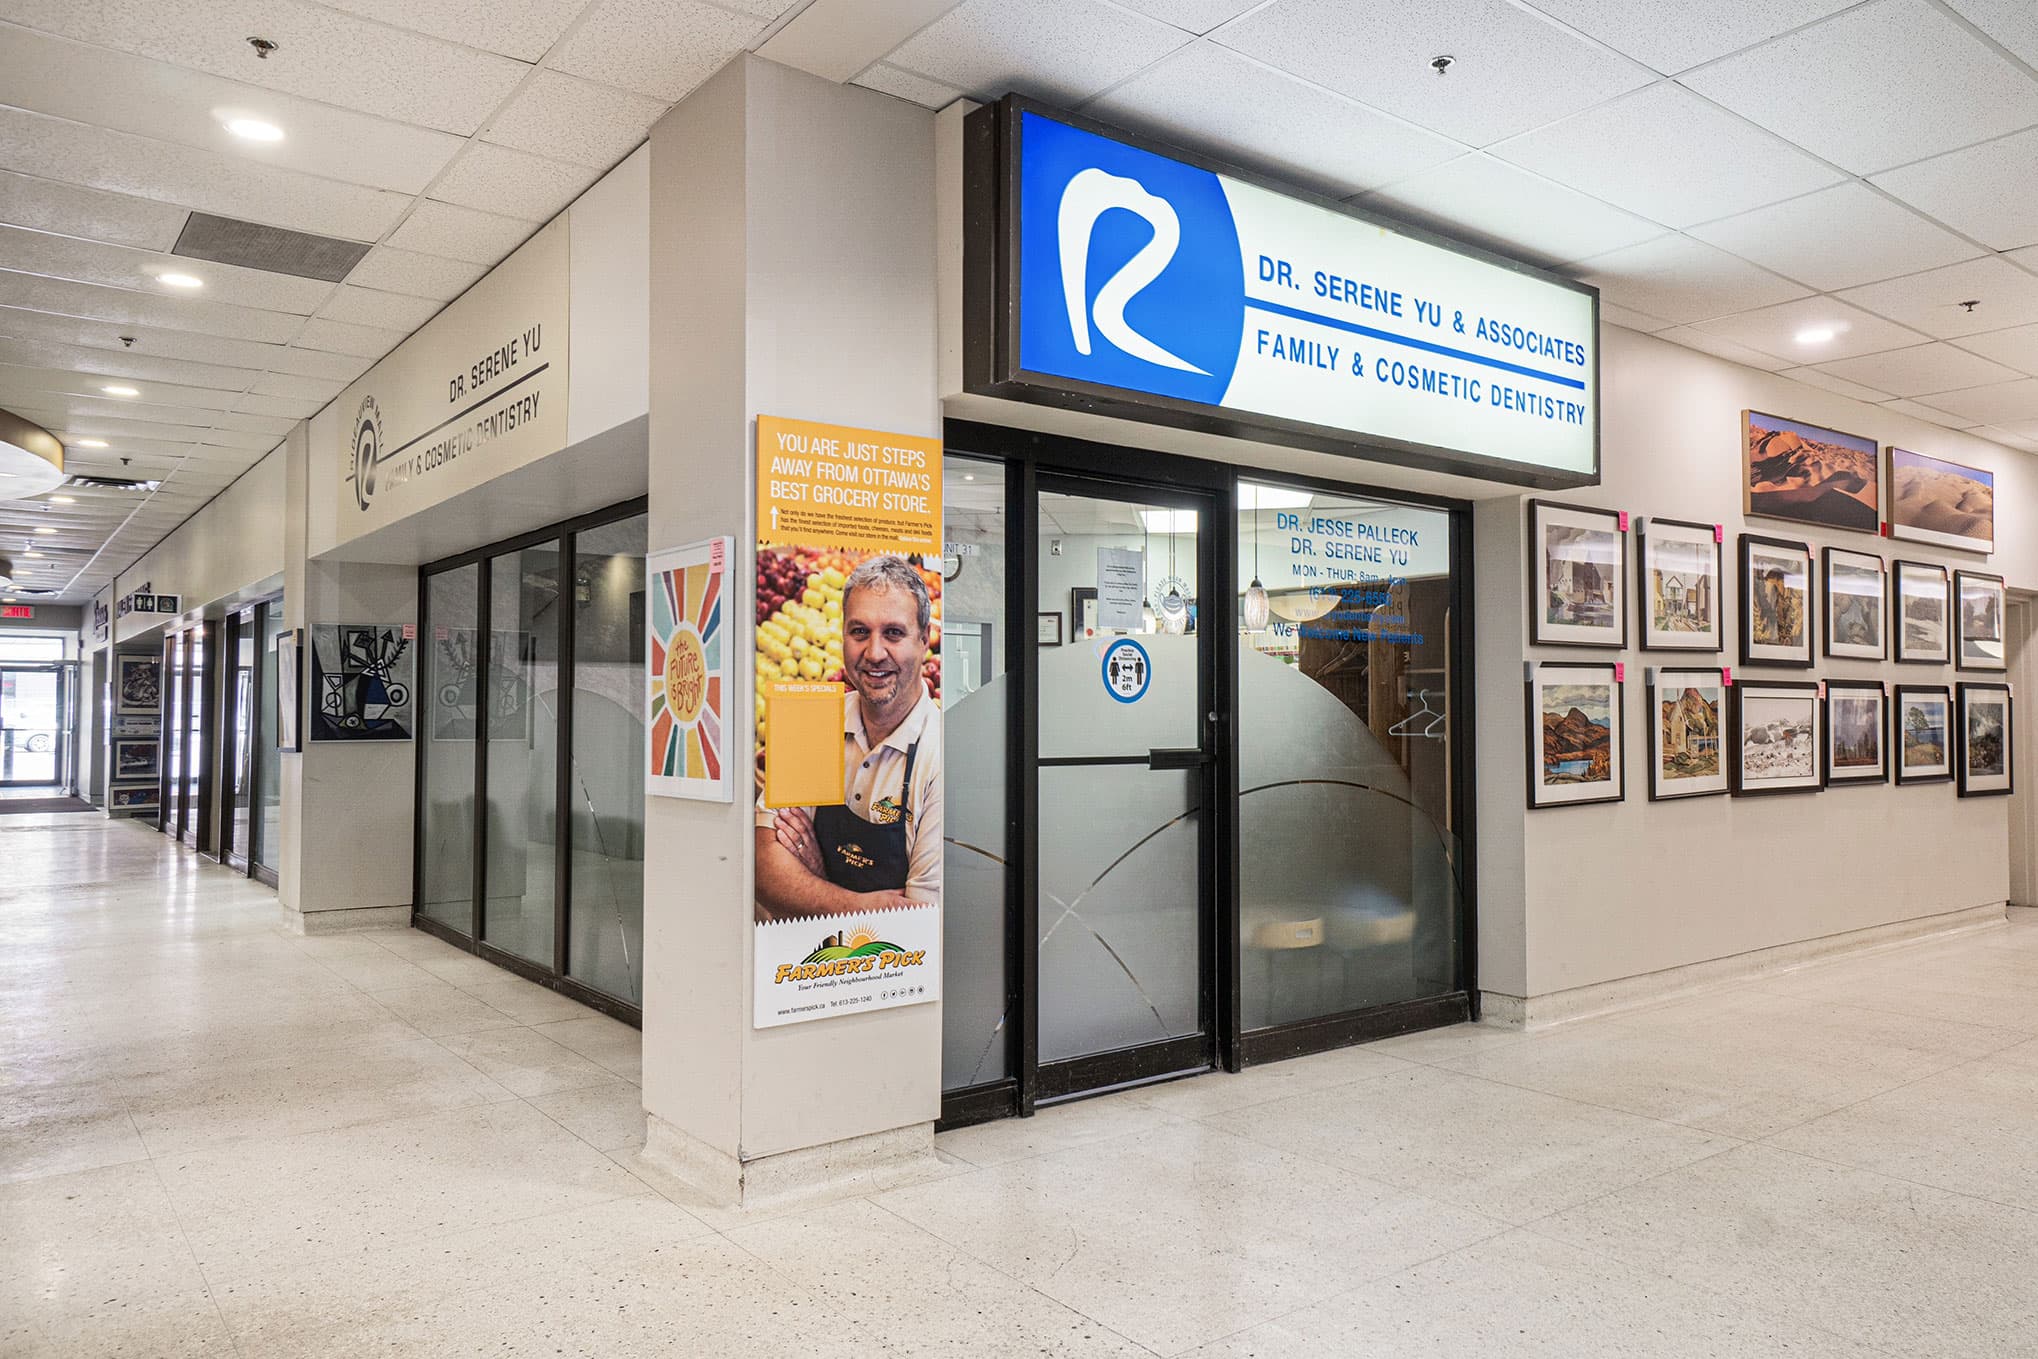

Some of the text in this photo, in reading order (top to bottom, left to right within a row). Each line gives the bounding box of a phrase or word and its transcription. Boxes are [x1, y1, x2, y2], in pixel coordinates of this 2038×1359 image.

[1258, 255, 1586, 367] DR. SERENE YU & ASSOCIATES
[450, 323, 541, 403] DR. SERENE YU
[1257, 331, 1585, 426] FAMILY & COSMETIC DENTISTRY
[416, 454, 422, 475] &
[425, 427, 473, 471] COSMETIC
[476, 391, 541, 447] DENTISTRY
[777, 432, 926, 468] YOU ARE JUST STEPS
[771, 456, 931, 491] AWAY FROM OTTAWA'S
[770, 480, 932, 514] BEST GROCERY STORE.
[1277, 512, 1419, 546] DR. JESSE PALLECK
[1291, 538, 1408, 566] DR. SERENE YU
[1292, 564, 1317, 577] MON
[676, 640, 688, 656] the
[1273, 623, 1292, 637] We
[1352, 628, 1376, 642] New
[670, 652, 699, 680] FUTURE
[774, 950, 926, 984] FARMER'S PICK
[798, 970, 904, 992] Your Friendly Neighbourhood Market
